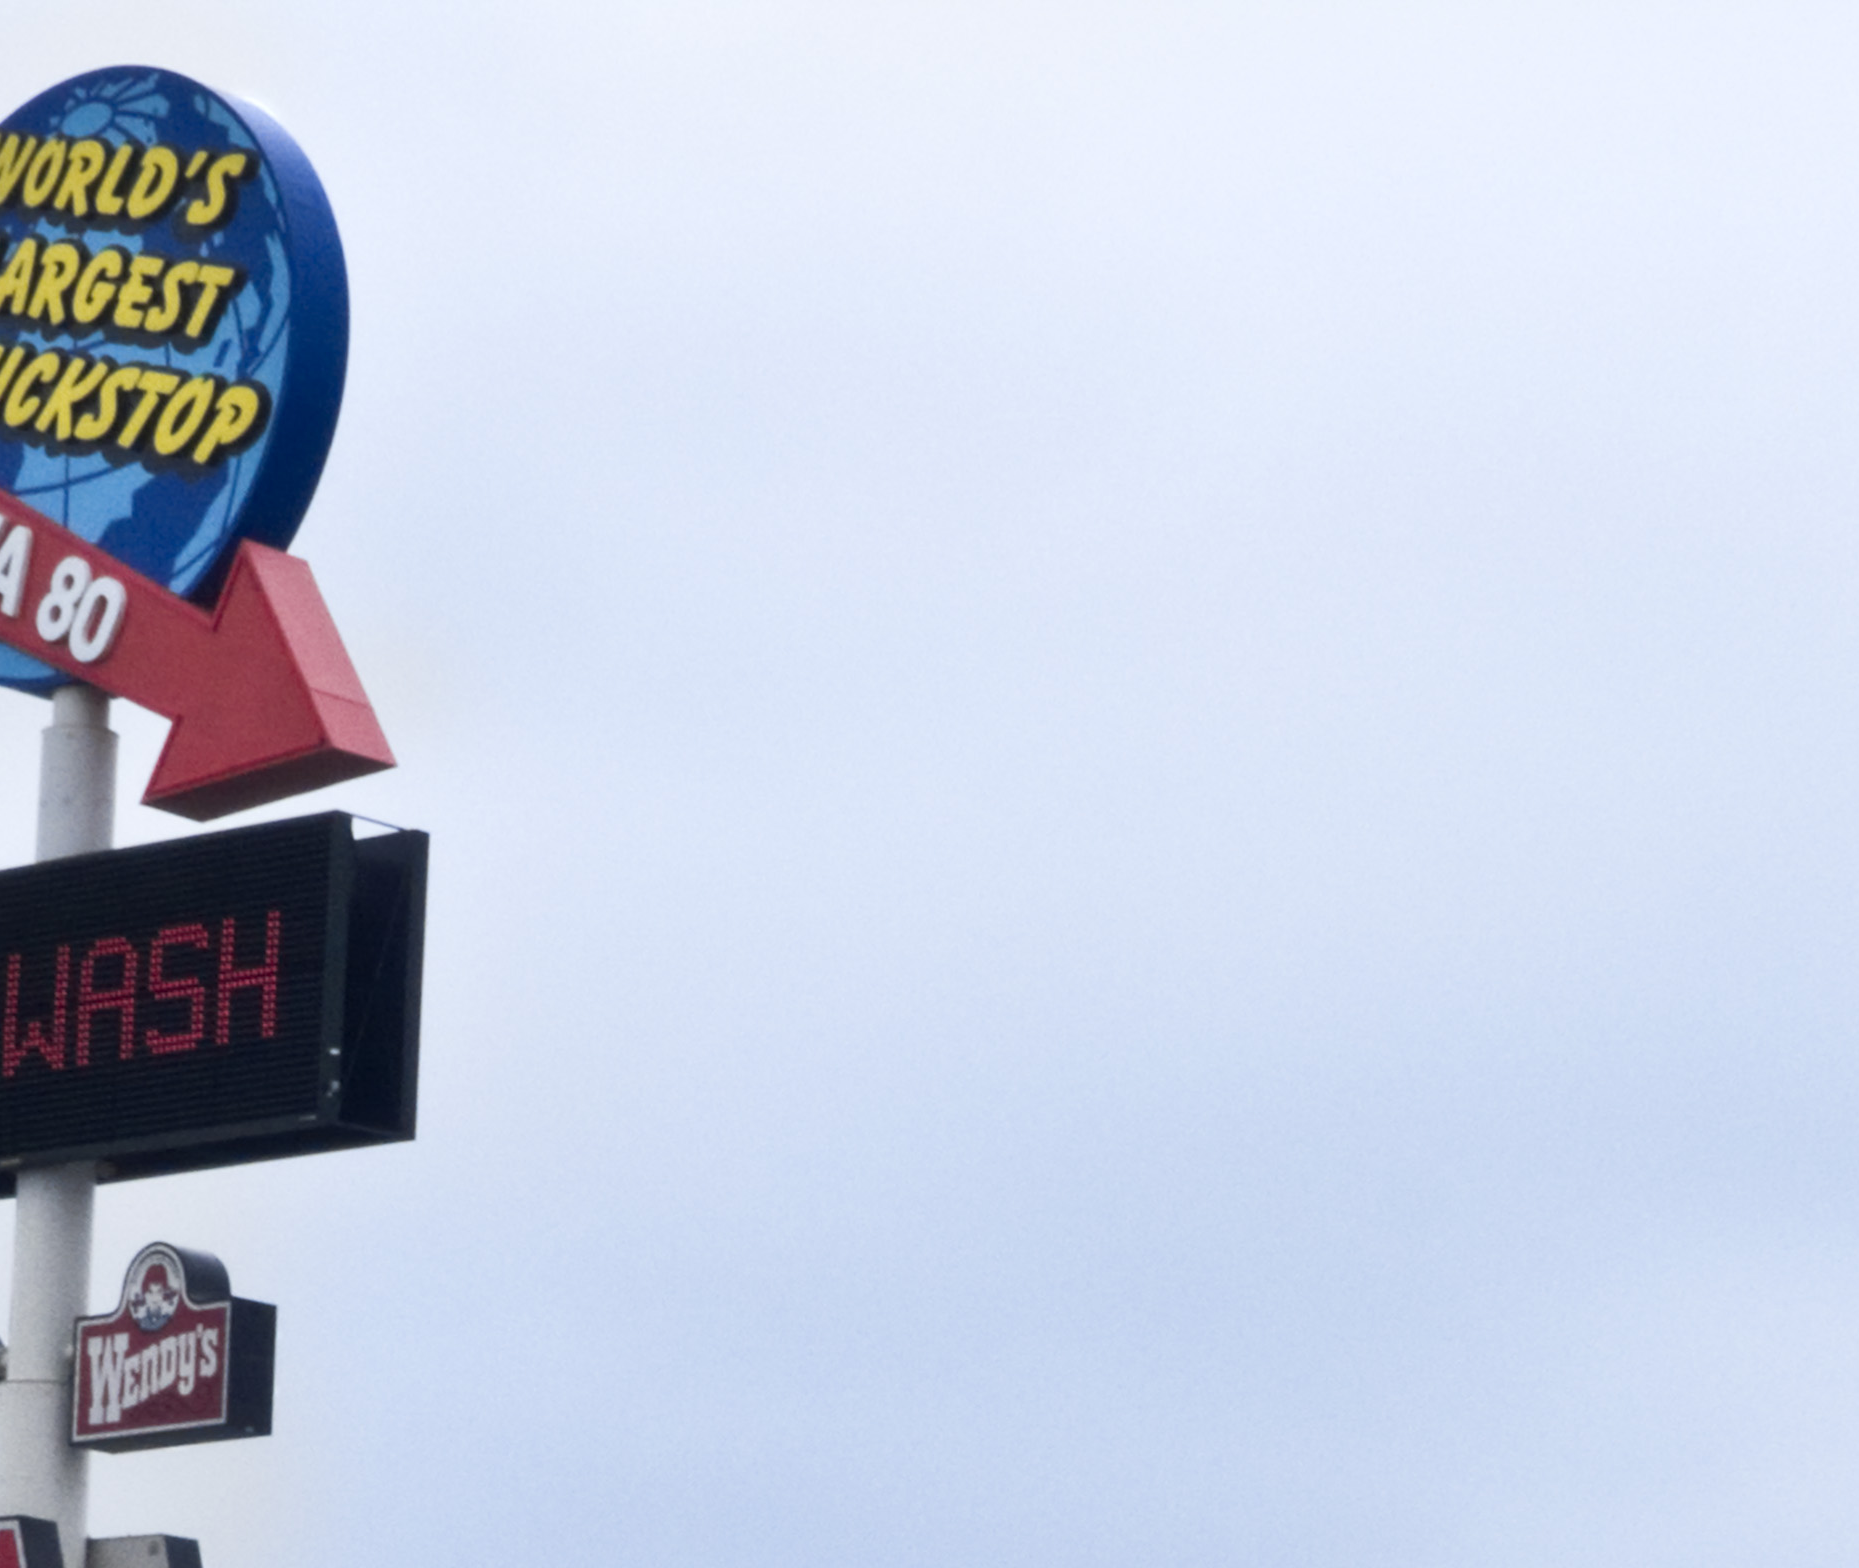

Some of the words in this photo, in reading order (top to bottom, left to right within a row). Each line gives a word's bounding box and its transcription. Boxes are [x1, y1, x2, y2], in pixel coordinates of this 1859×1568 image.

[35, 555, 128, 665] 80
[1, 909, 282, 1080] WASH
[87, 1322, 220, 1426] Wendy's
